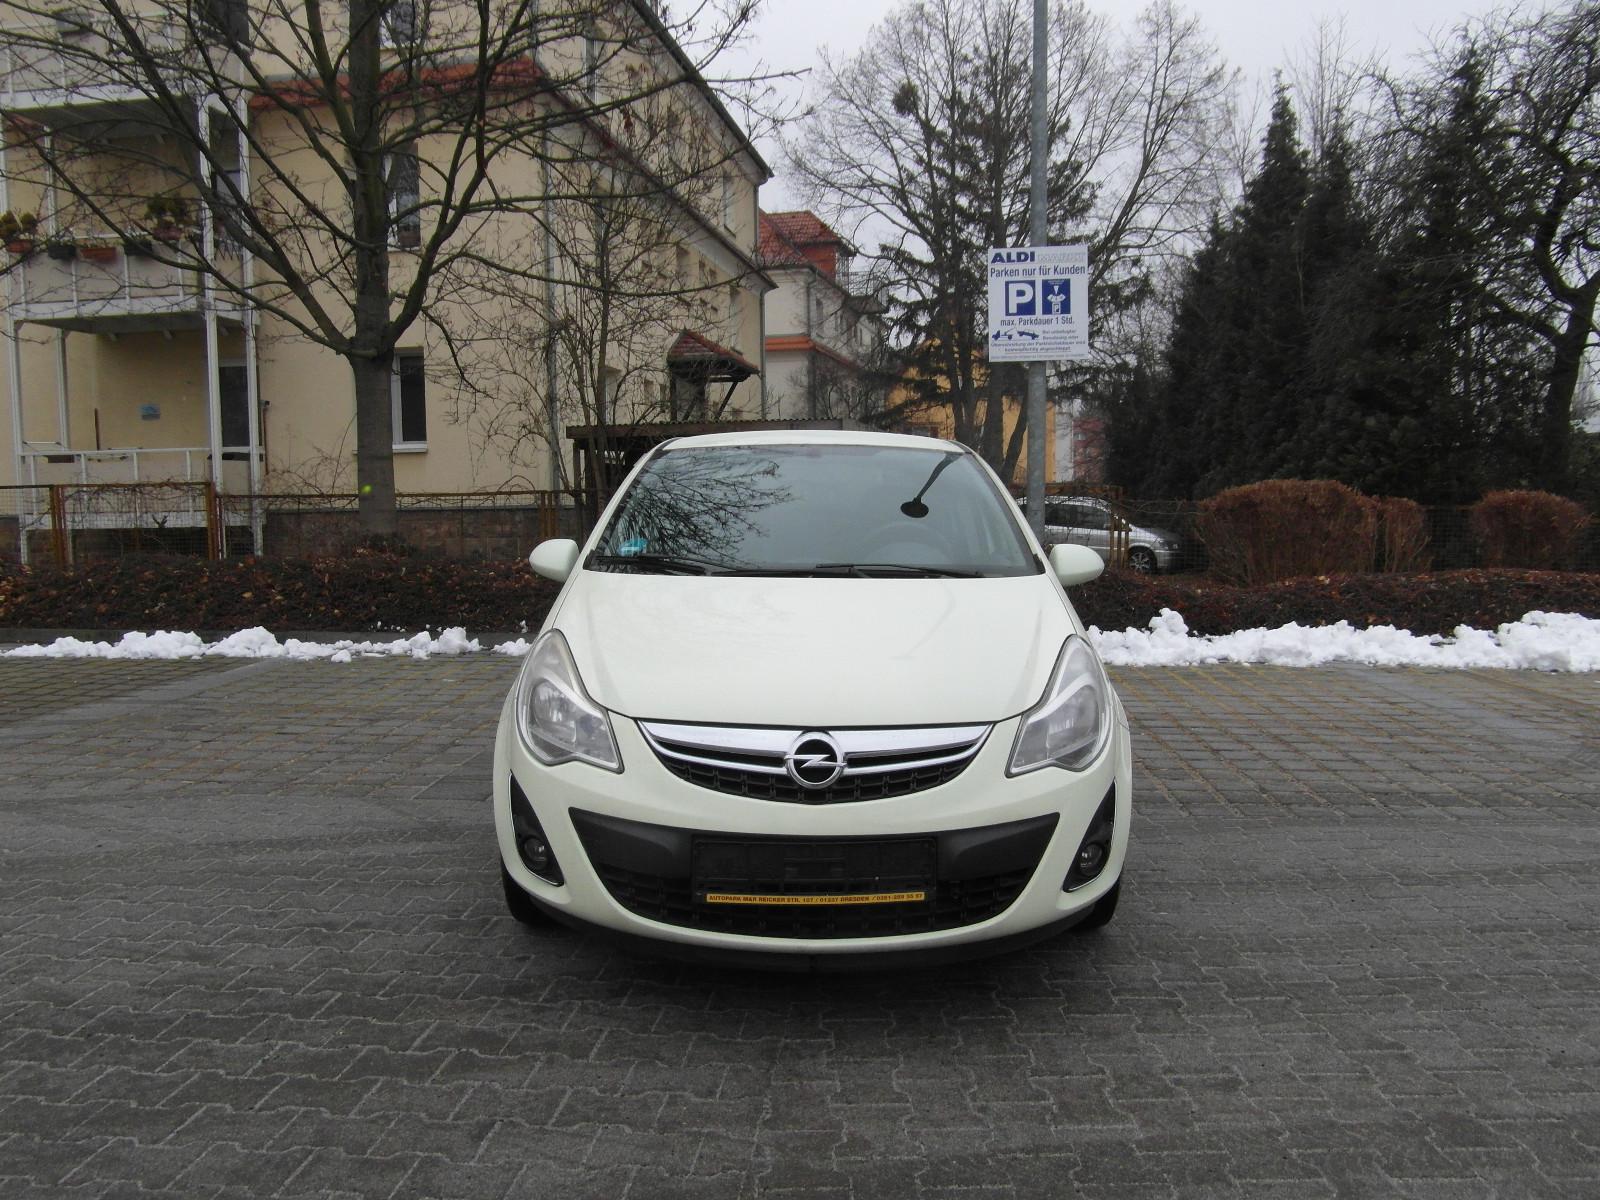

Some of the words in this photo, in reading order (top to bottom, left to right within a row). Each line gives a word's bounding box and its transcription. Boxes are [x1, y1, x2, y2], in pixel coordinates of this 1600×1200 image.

[991, 251, 1035, 263] ALDI
[991, 267, 1019, 277] Parken
[1022, 268, 1036, 276] nur
[1039, 266, 1051, 275] für
[1054, 265, 1085, 275] Kunden
[1009, 283, 1033, 313] P
[1018, 317, 1053, 326] Parkdauer
[1061, 316, 1075, 324] Std.
